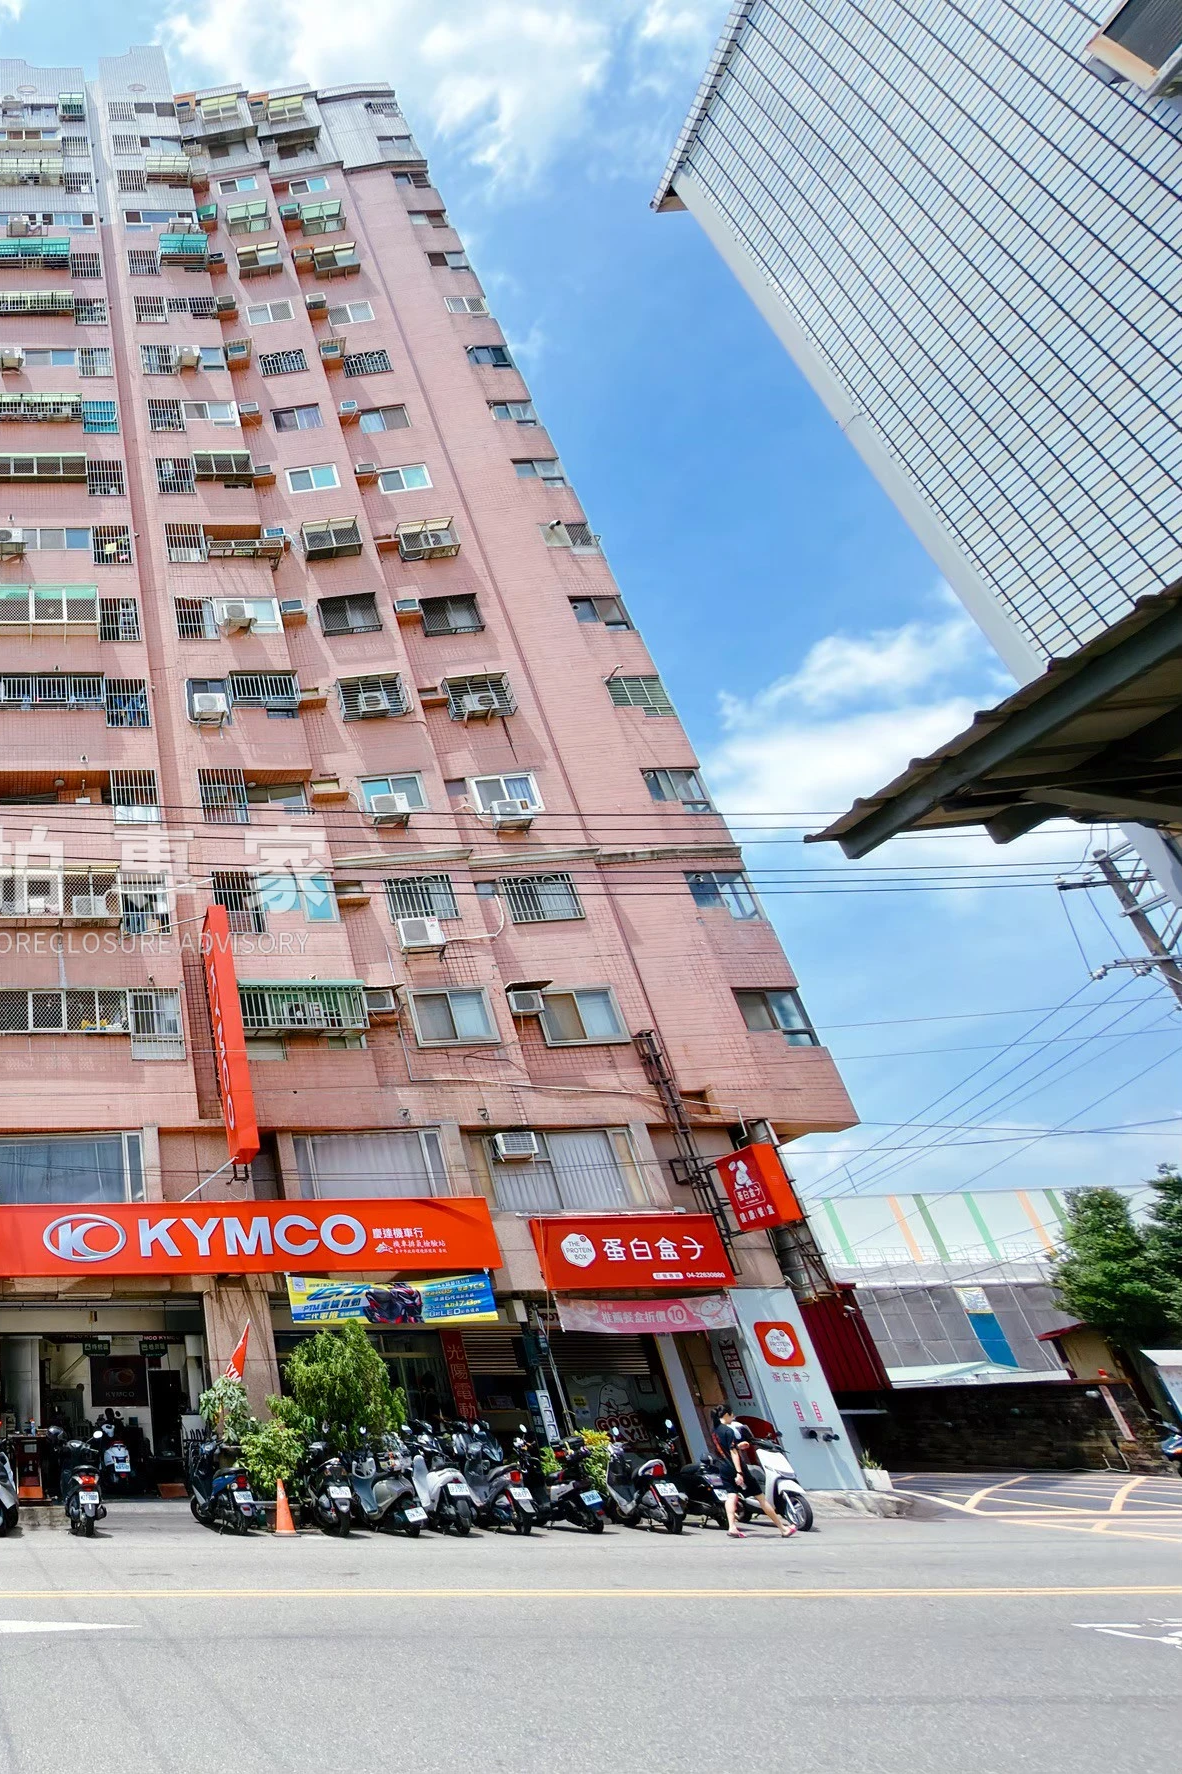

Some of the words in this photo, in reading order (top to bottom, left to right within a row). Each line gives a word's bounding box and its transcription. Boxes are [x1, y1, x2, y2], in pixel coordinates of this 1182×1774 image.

[137, 1213, 367, 1258] KYMCO
[602, 1235, 704, 1261] 蛋白盒子
[669, 1309, 684, 1321] 10
[771, 1371, 810, 1383] 蛋白盒子
[595, 1412, 643, 1432] GOOD
